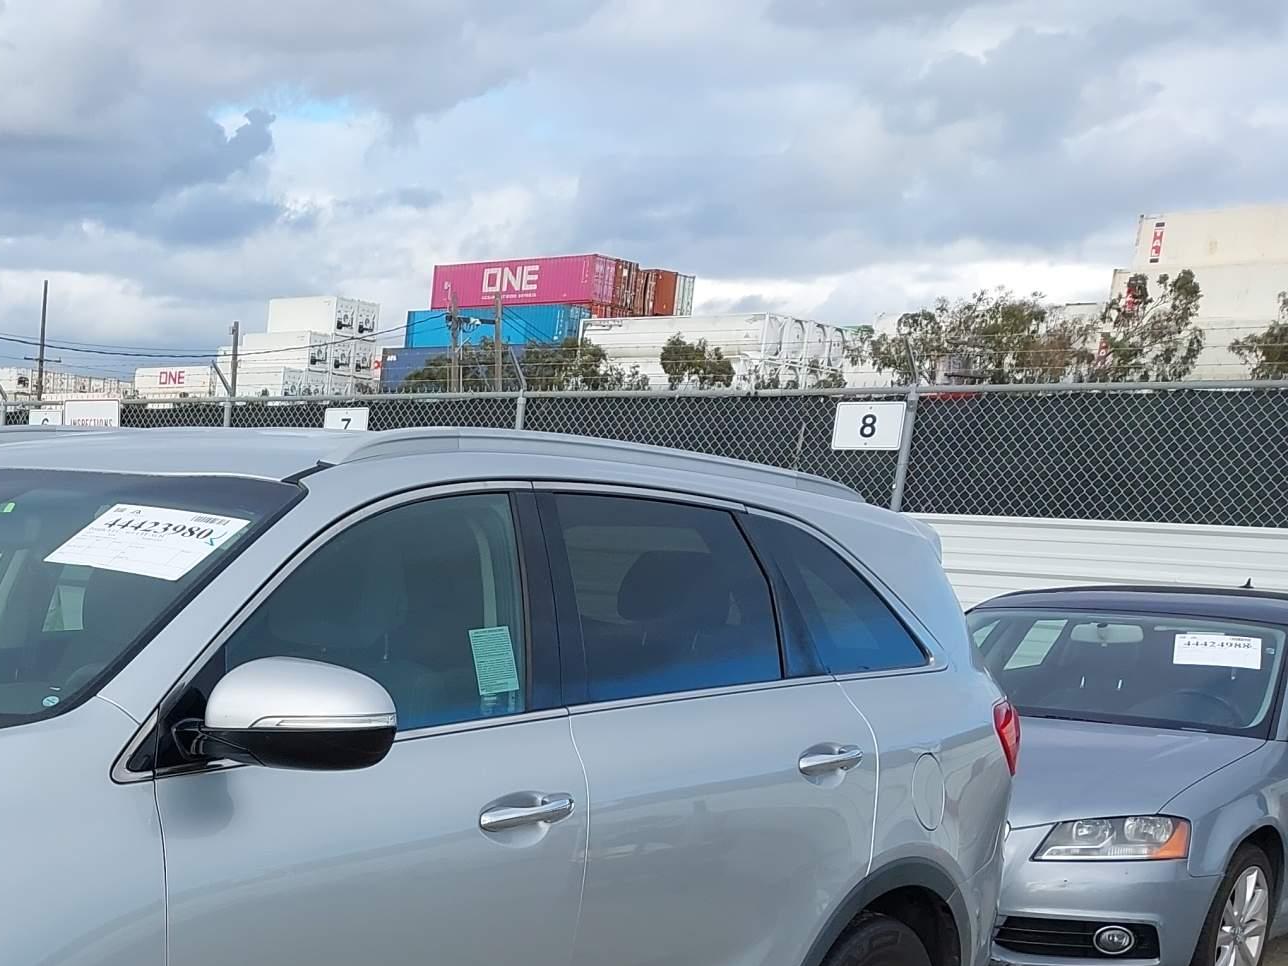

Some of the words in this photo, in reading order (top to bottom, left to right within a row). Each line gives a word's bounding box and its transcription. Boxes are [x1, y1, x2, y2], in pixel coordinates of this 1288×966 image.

[482, 265, 539, 292] ONE
[159, 371, 185, 385] ONE
[341, 418, 352, 430] 7
[859, 413, 877, 438] 8
[104, 517, 214, 540] 44423980
